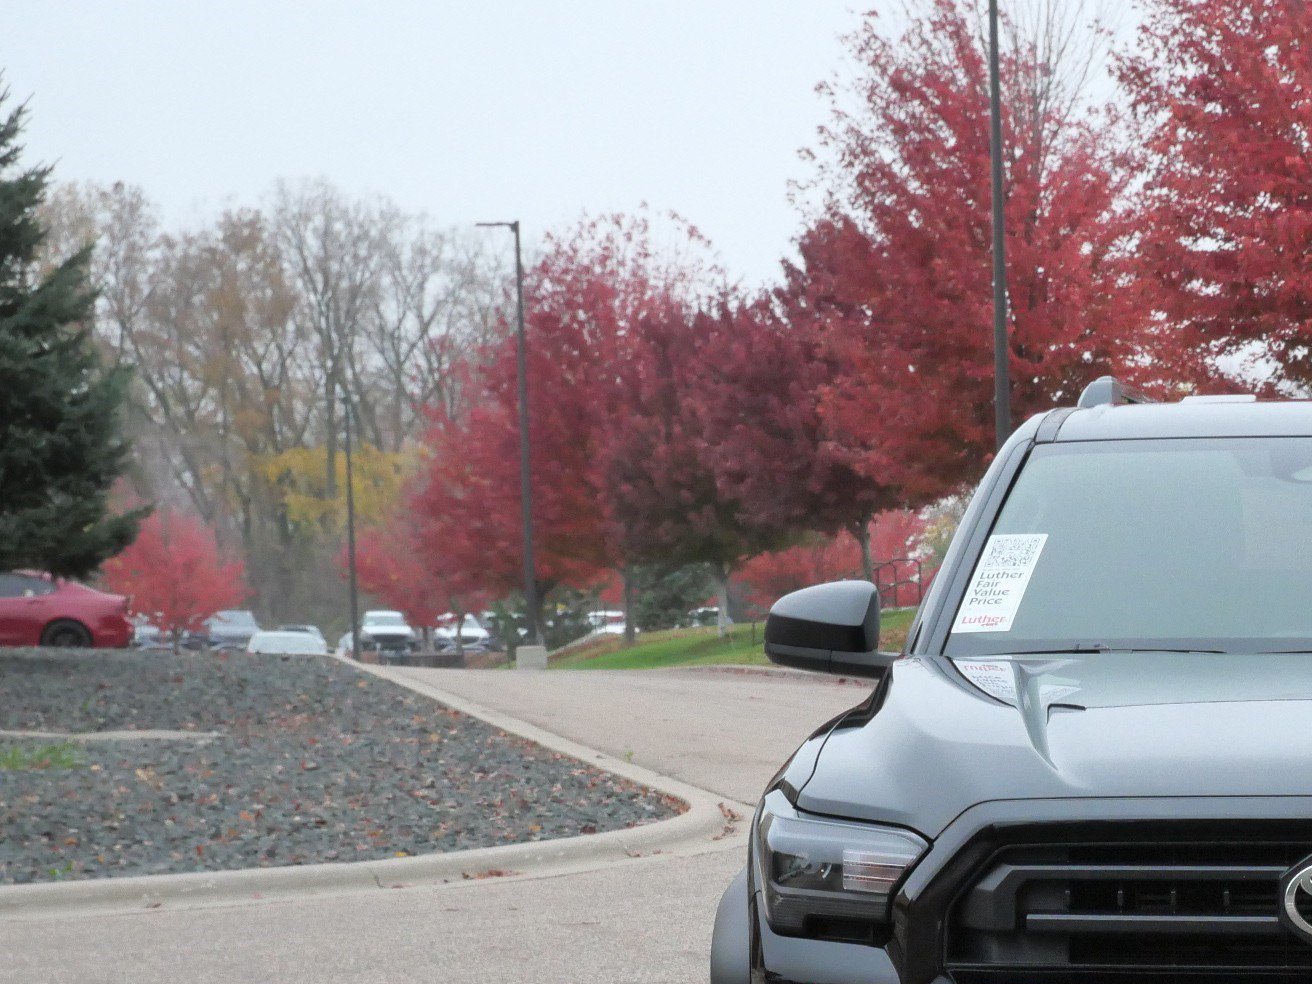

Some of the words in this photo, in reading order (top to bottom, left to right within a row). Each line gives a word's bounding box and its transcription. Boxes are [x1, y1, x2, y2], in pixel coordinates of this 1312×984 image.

[980, 571, 1024, 580] Luther
[977, 580, 1001, 588] Fair
[974, 588, 1010, 597] Value
[969, 597, 1002, 606] Price
[962, 615, 1006, 625] Luther
